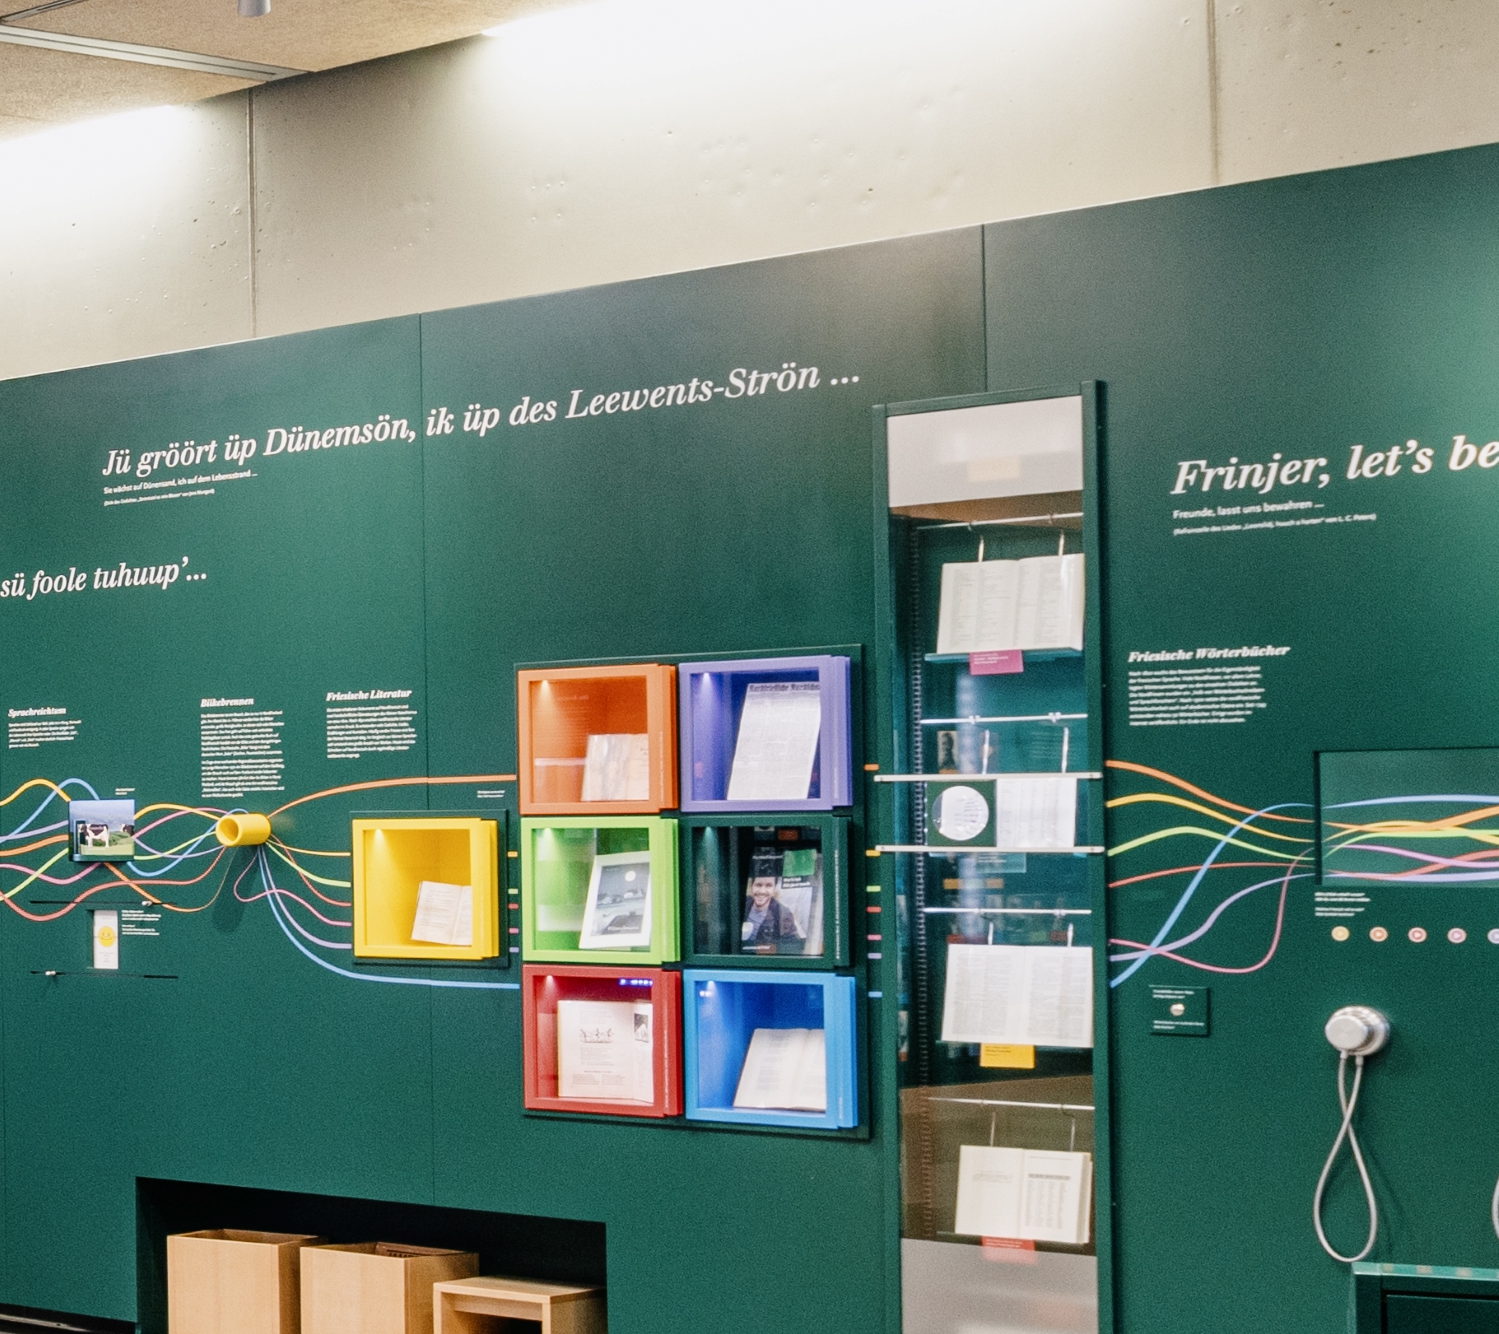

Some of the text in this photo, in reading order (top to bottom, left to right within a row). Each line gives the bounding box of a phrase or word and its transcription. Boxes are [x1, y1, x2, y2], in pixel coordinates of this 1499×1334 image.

[102, 448, 131, 475] Jü
[135, 439, 217, 477] gröört
[224, 434, 256, 465] üp
[262, 414, 415, 455] Dünemsön,
[426, 406, 454, 436] ik
[463, 403, 499, 436] üp
[508, 396, 557, 425] des
[564, 361, 820, 418] Leewents-Strön
[1170, 452, 1329, 494] Frinjer,
[1346, 439, 1434, 479] let’s
[0, 572, 25, 597] sü
[26, 567, 86, 600] foole
[93, 556, 206, 589] tuhuup’...
[1127, 644, 1290, 662] Friesische Wörterbücher
[325, 689, 412, 701] Friesische Literatur
